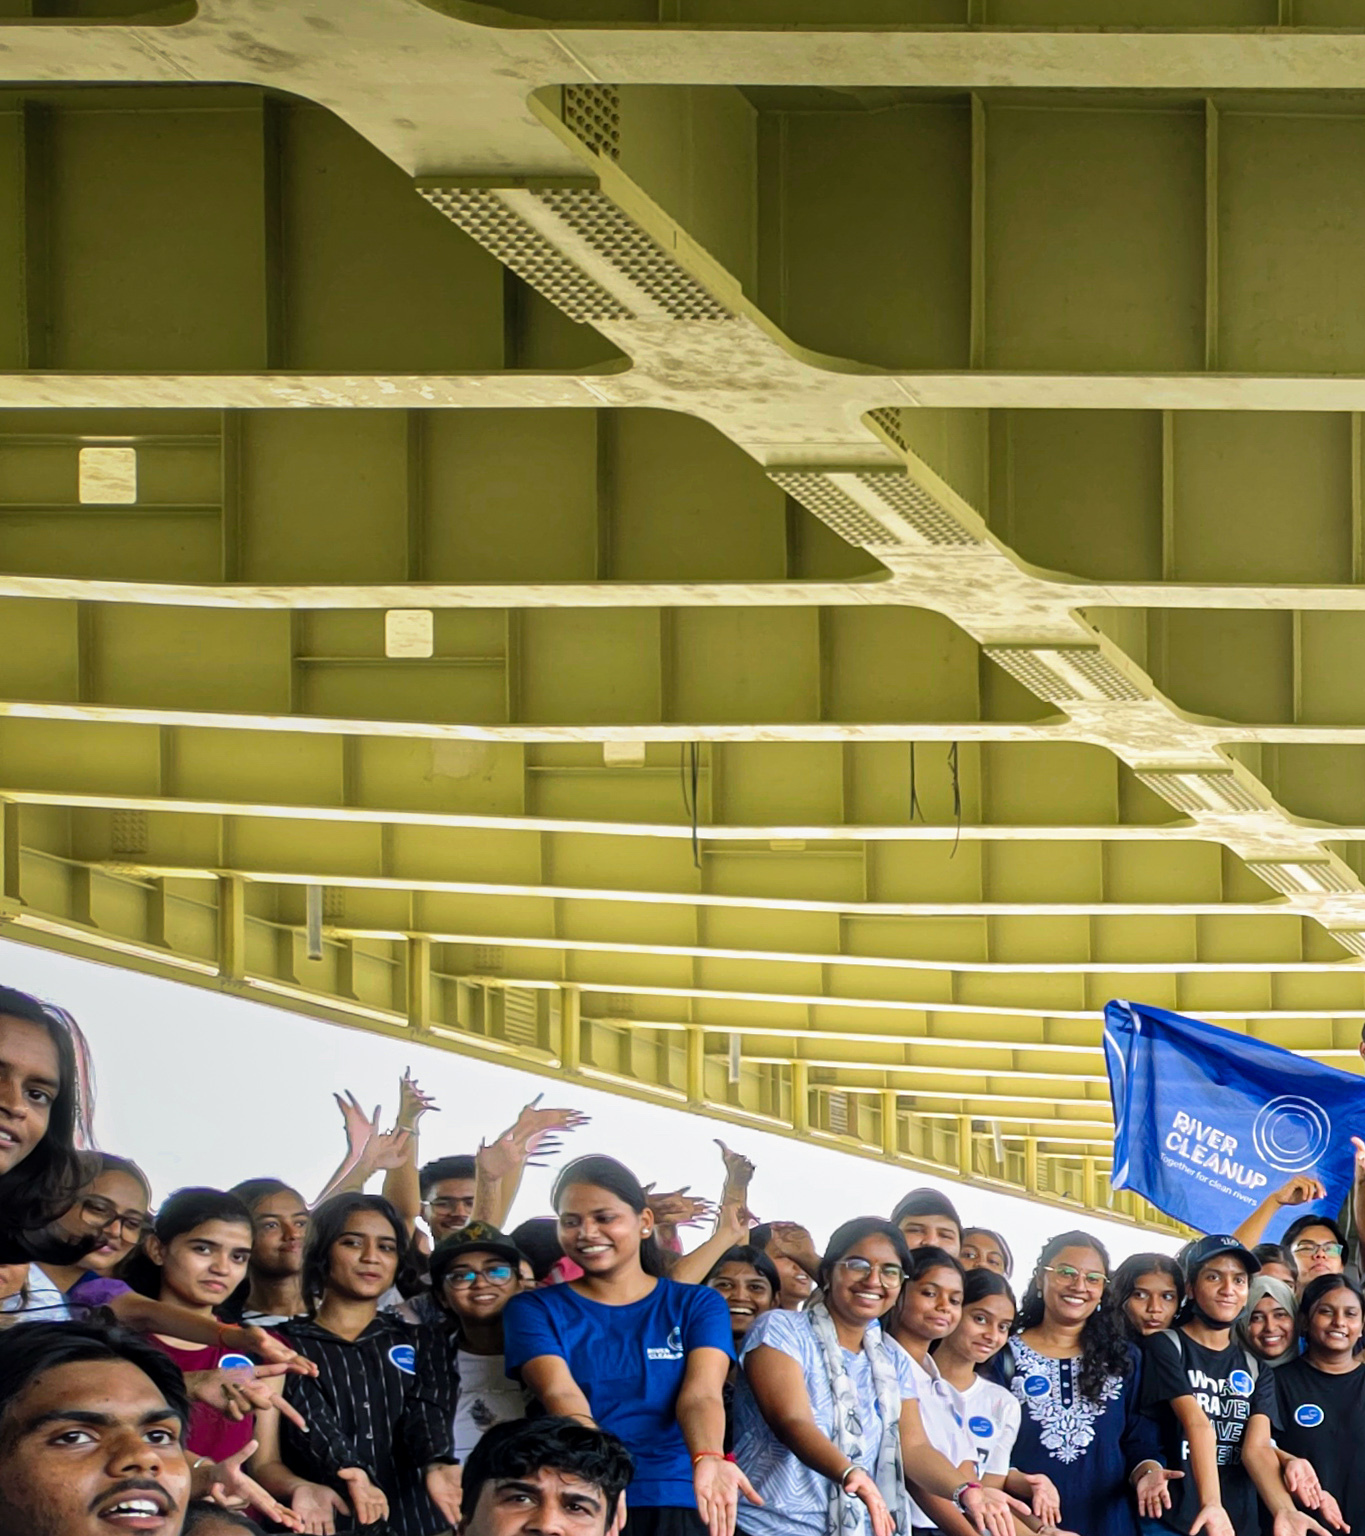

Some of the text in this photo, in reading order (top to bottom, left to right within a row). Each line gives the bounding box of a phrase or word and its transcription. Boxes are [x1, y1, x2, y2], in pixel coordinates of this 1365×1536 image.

[1165, 1131, 1268, 1189] CLEANUP
[1172, 1110, 1238, 1157] RIVER
[1160, 1152, 1258, 1207] Together for clean rivers
